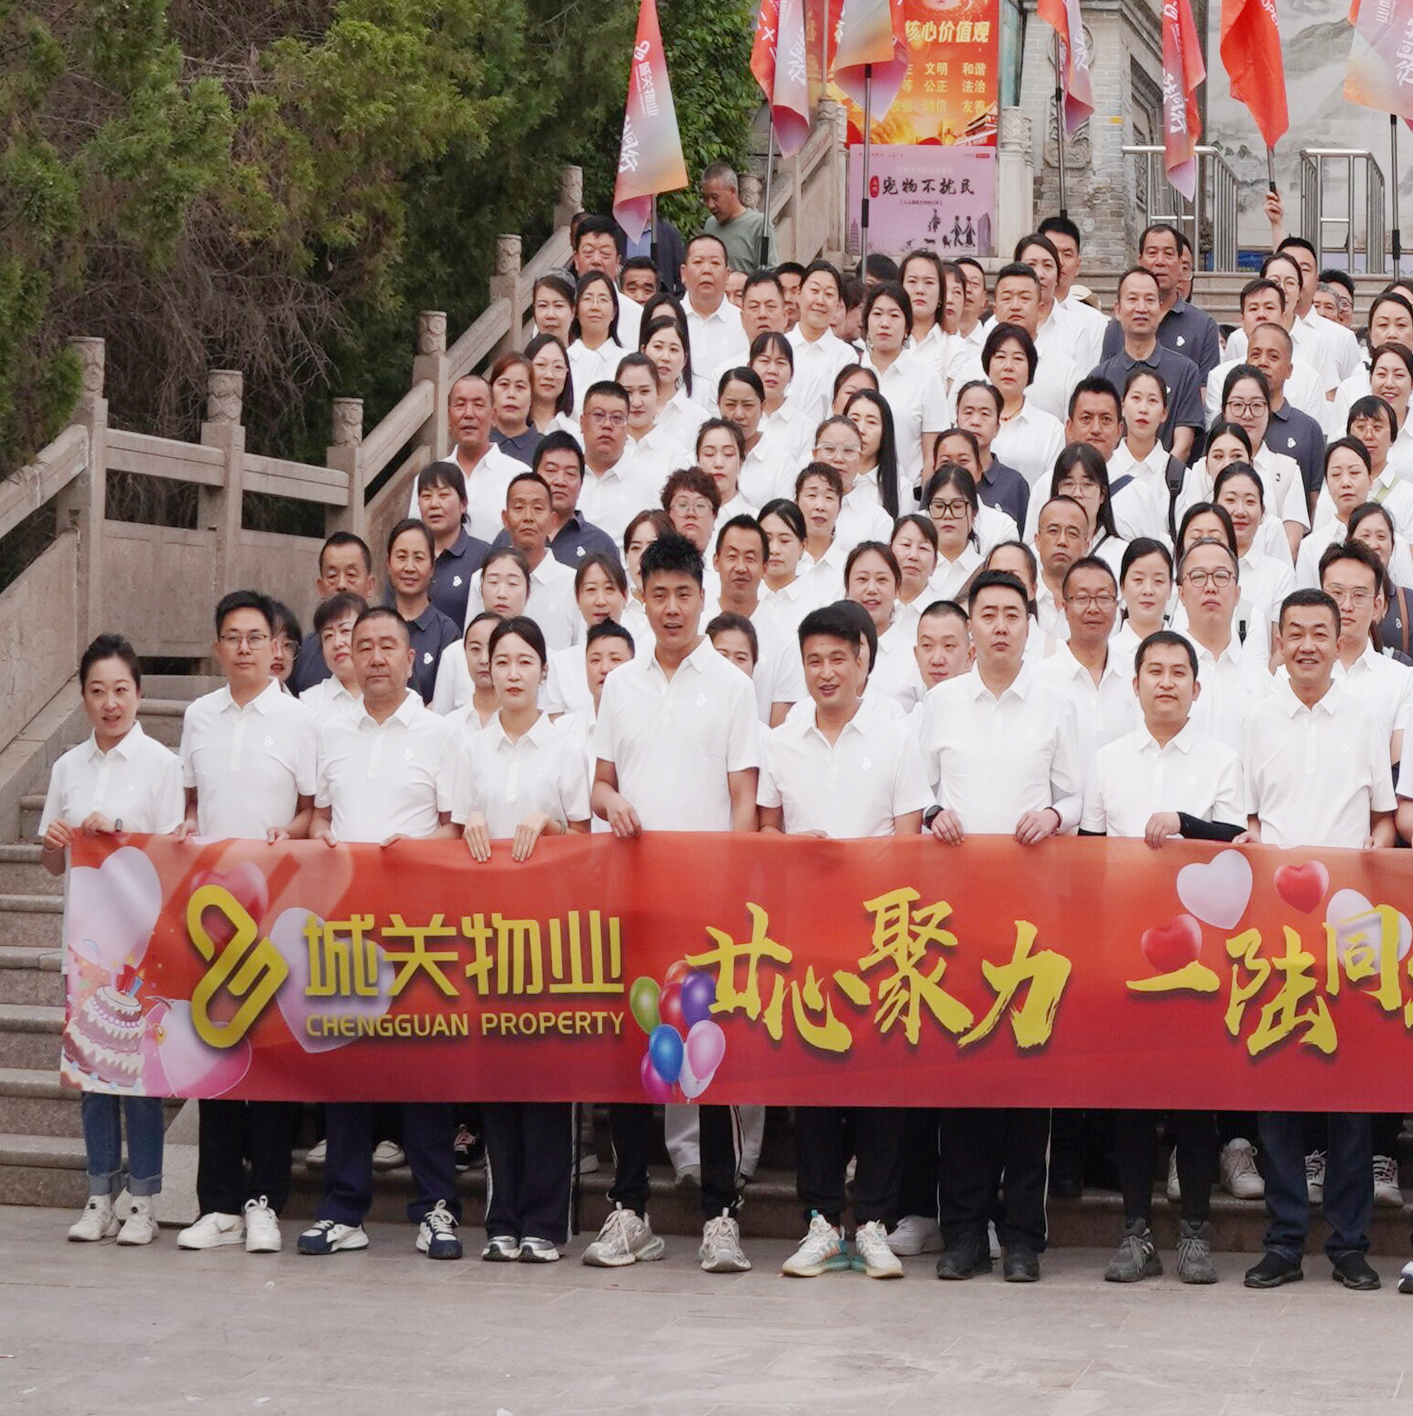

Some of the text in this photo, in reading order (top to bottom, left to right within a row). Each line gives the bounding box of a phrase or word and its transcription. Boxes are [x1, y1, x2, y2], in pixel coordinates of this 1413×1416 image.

[304, 909, 625, 997] 城关物业
[305, 1011, 625, 1038] CHENGGUAN PROPERTY
